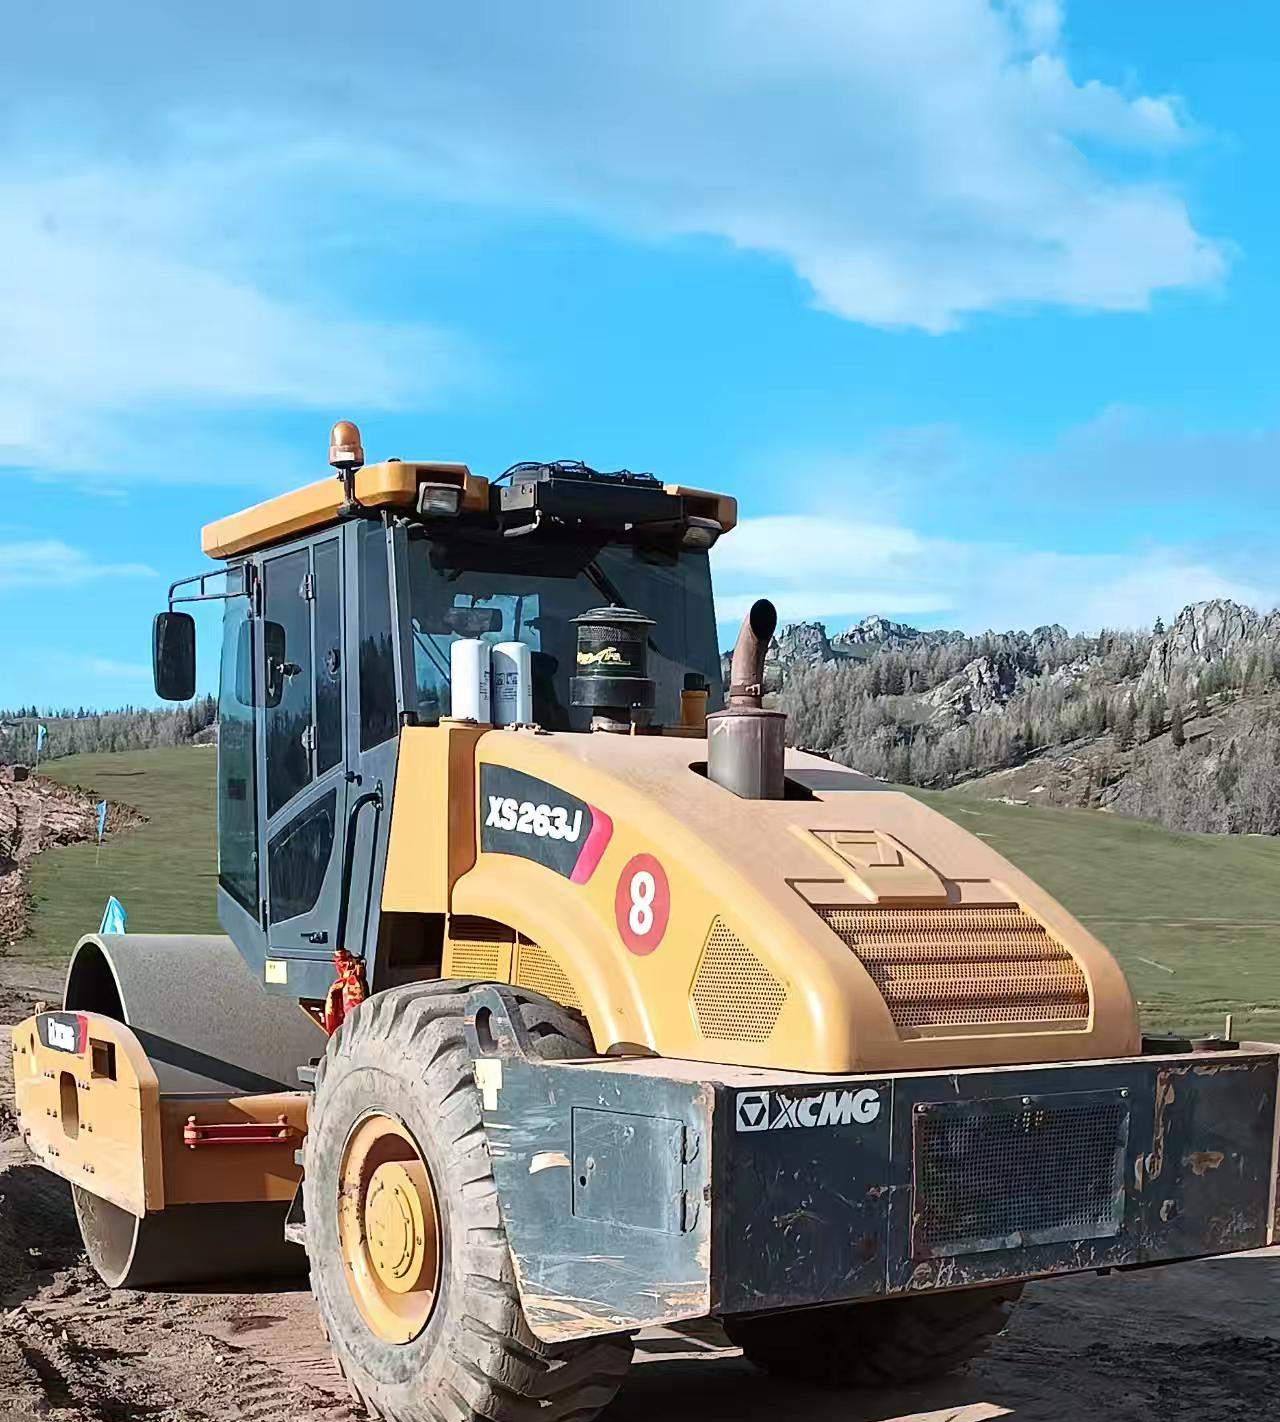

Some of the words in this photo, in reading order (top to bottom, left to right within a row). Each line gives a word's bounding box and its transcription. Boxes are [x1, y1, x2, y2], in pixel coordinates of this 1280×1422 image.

[485, 796, 583, 843] XS263J
[629, 871, 656, 936] 8
[769, 1088, 881, 1129] XCMG
